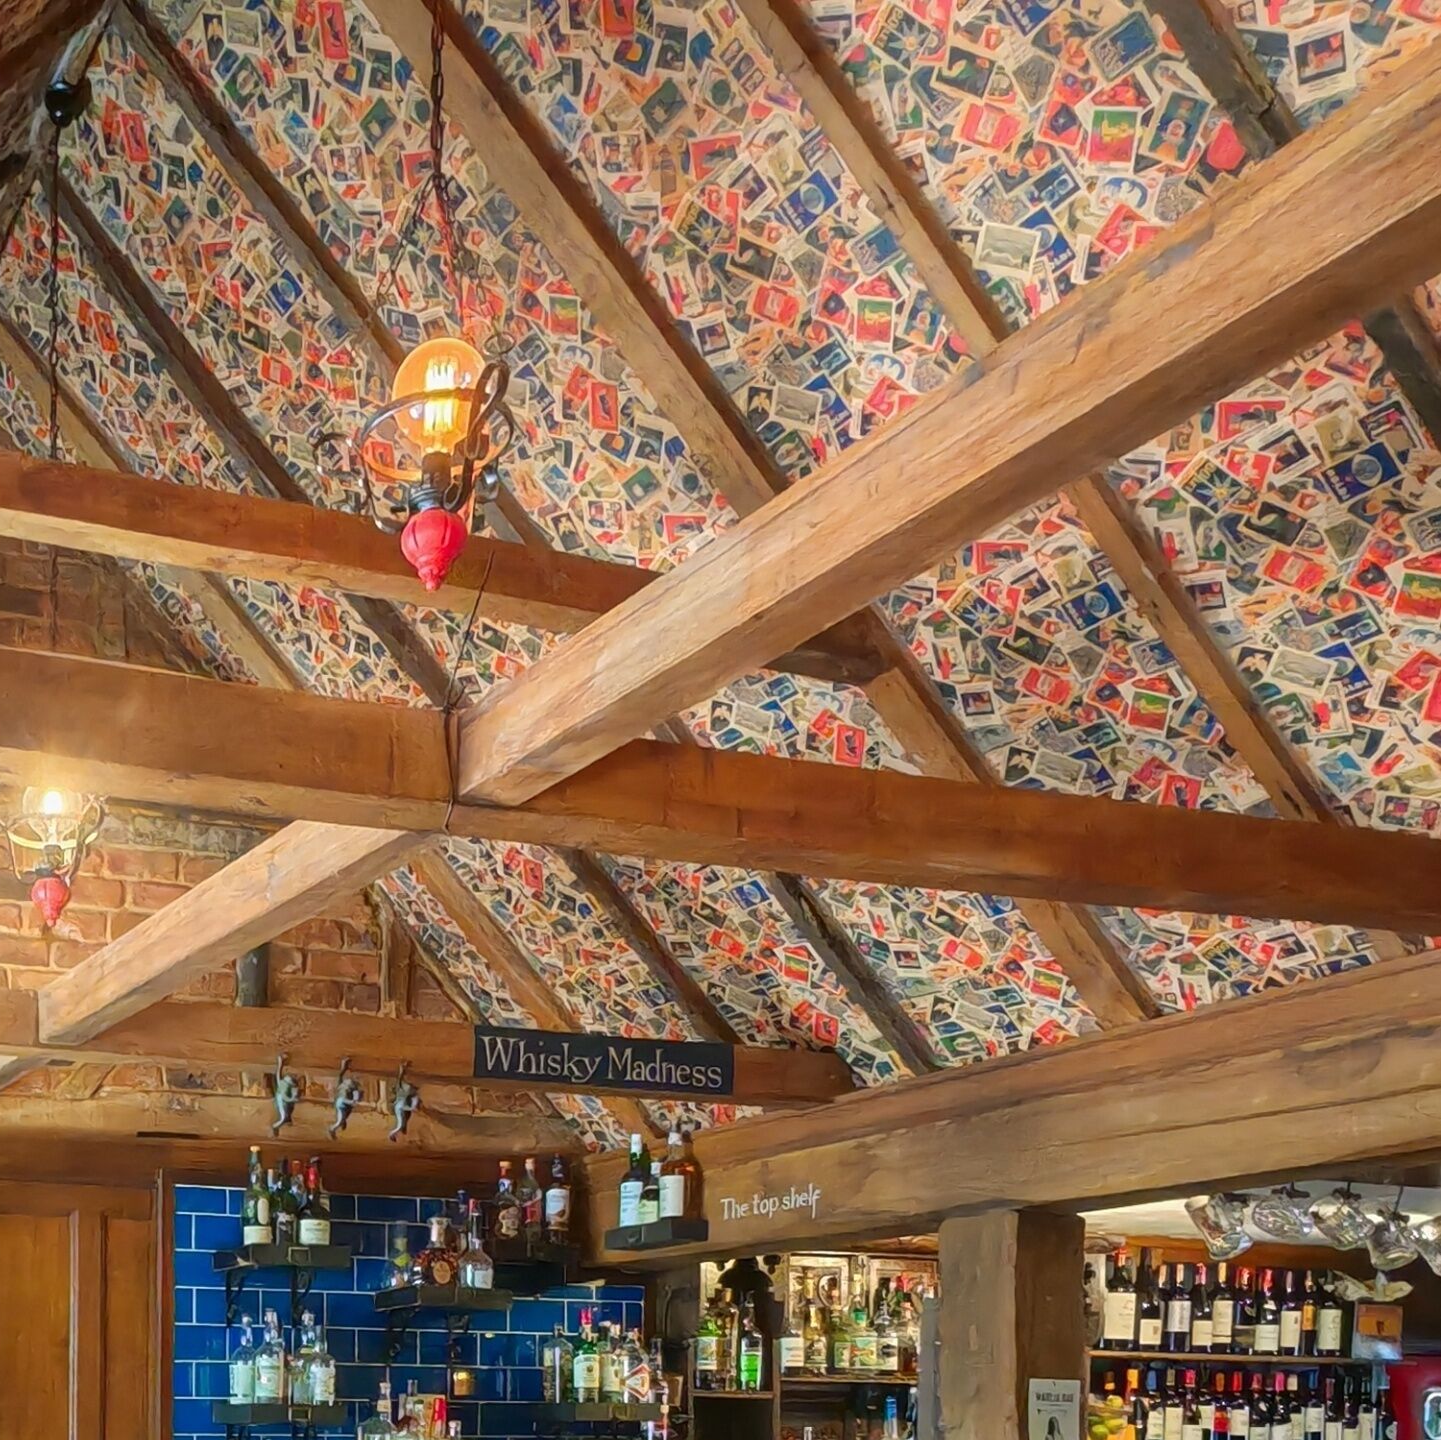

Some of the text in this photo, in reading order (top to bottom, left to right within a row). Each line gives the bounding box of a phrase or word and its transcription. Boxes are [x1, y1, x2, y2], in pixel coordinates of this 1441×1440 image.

[479, 1035, 723, 1089] Whisky Madness
[719, 1182, 822, 1221] The top shelf
